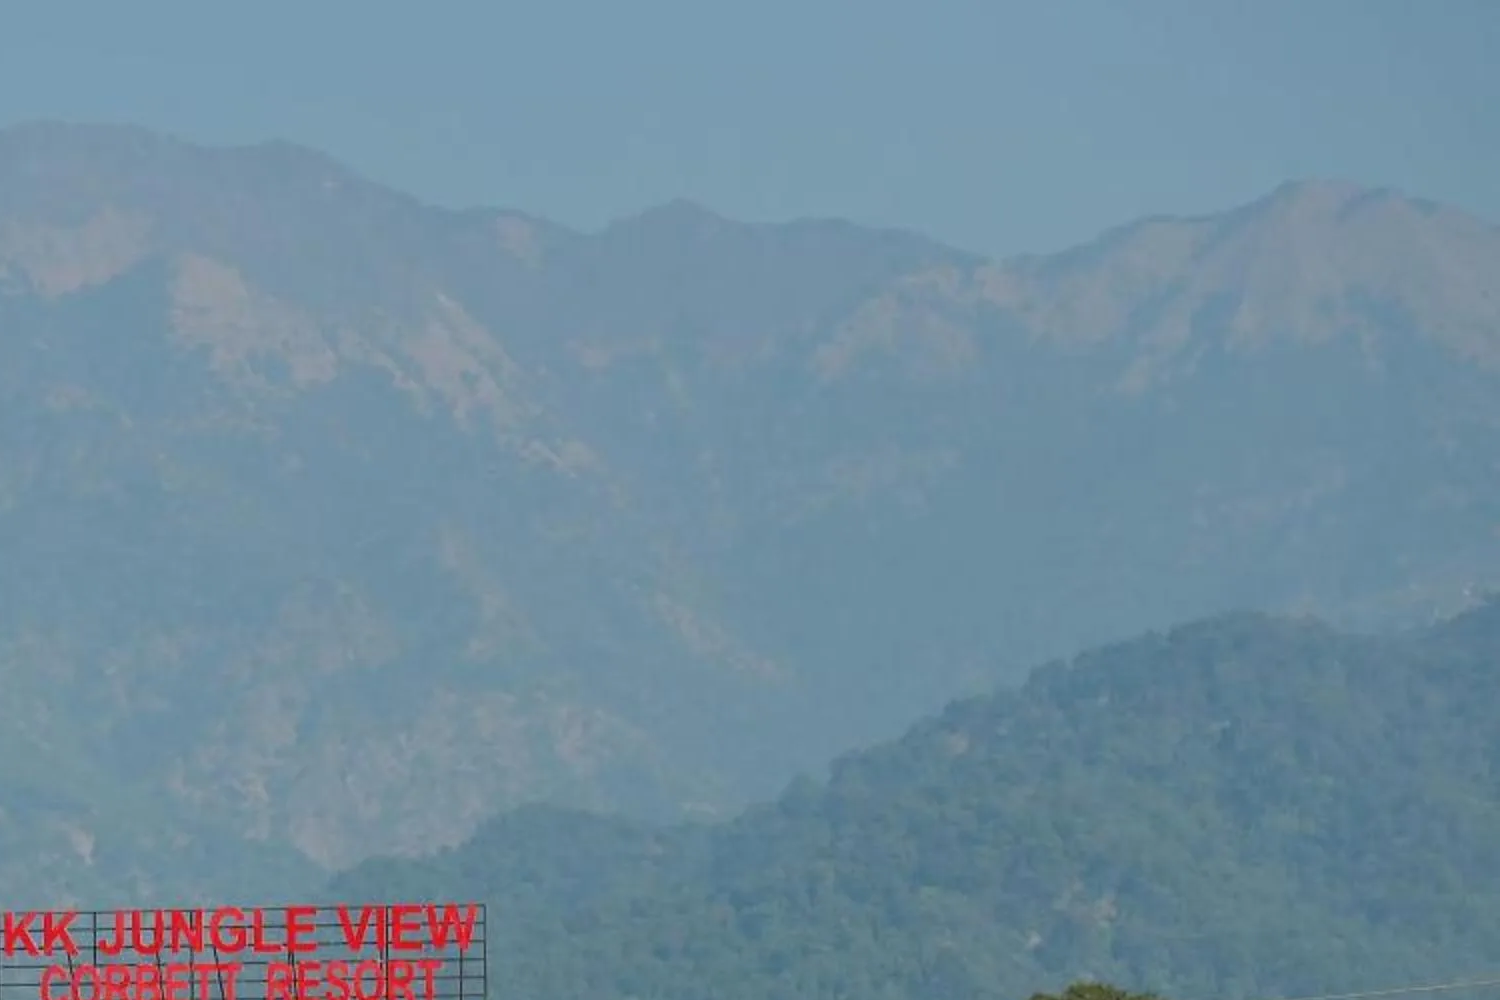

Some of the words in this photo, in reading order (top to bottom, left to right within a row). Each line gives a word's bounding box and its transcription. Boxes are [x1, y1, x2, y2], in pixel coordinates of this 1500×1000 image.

[3, 910, 79, 957] KK
[98, 905, 318, 957] JUNGLE
[337, 902, 479, 953] VIEW
